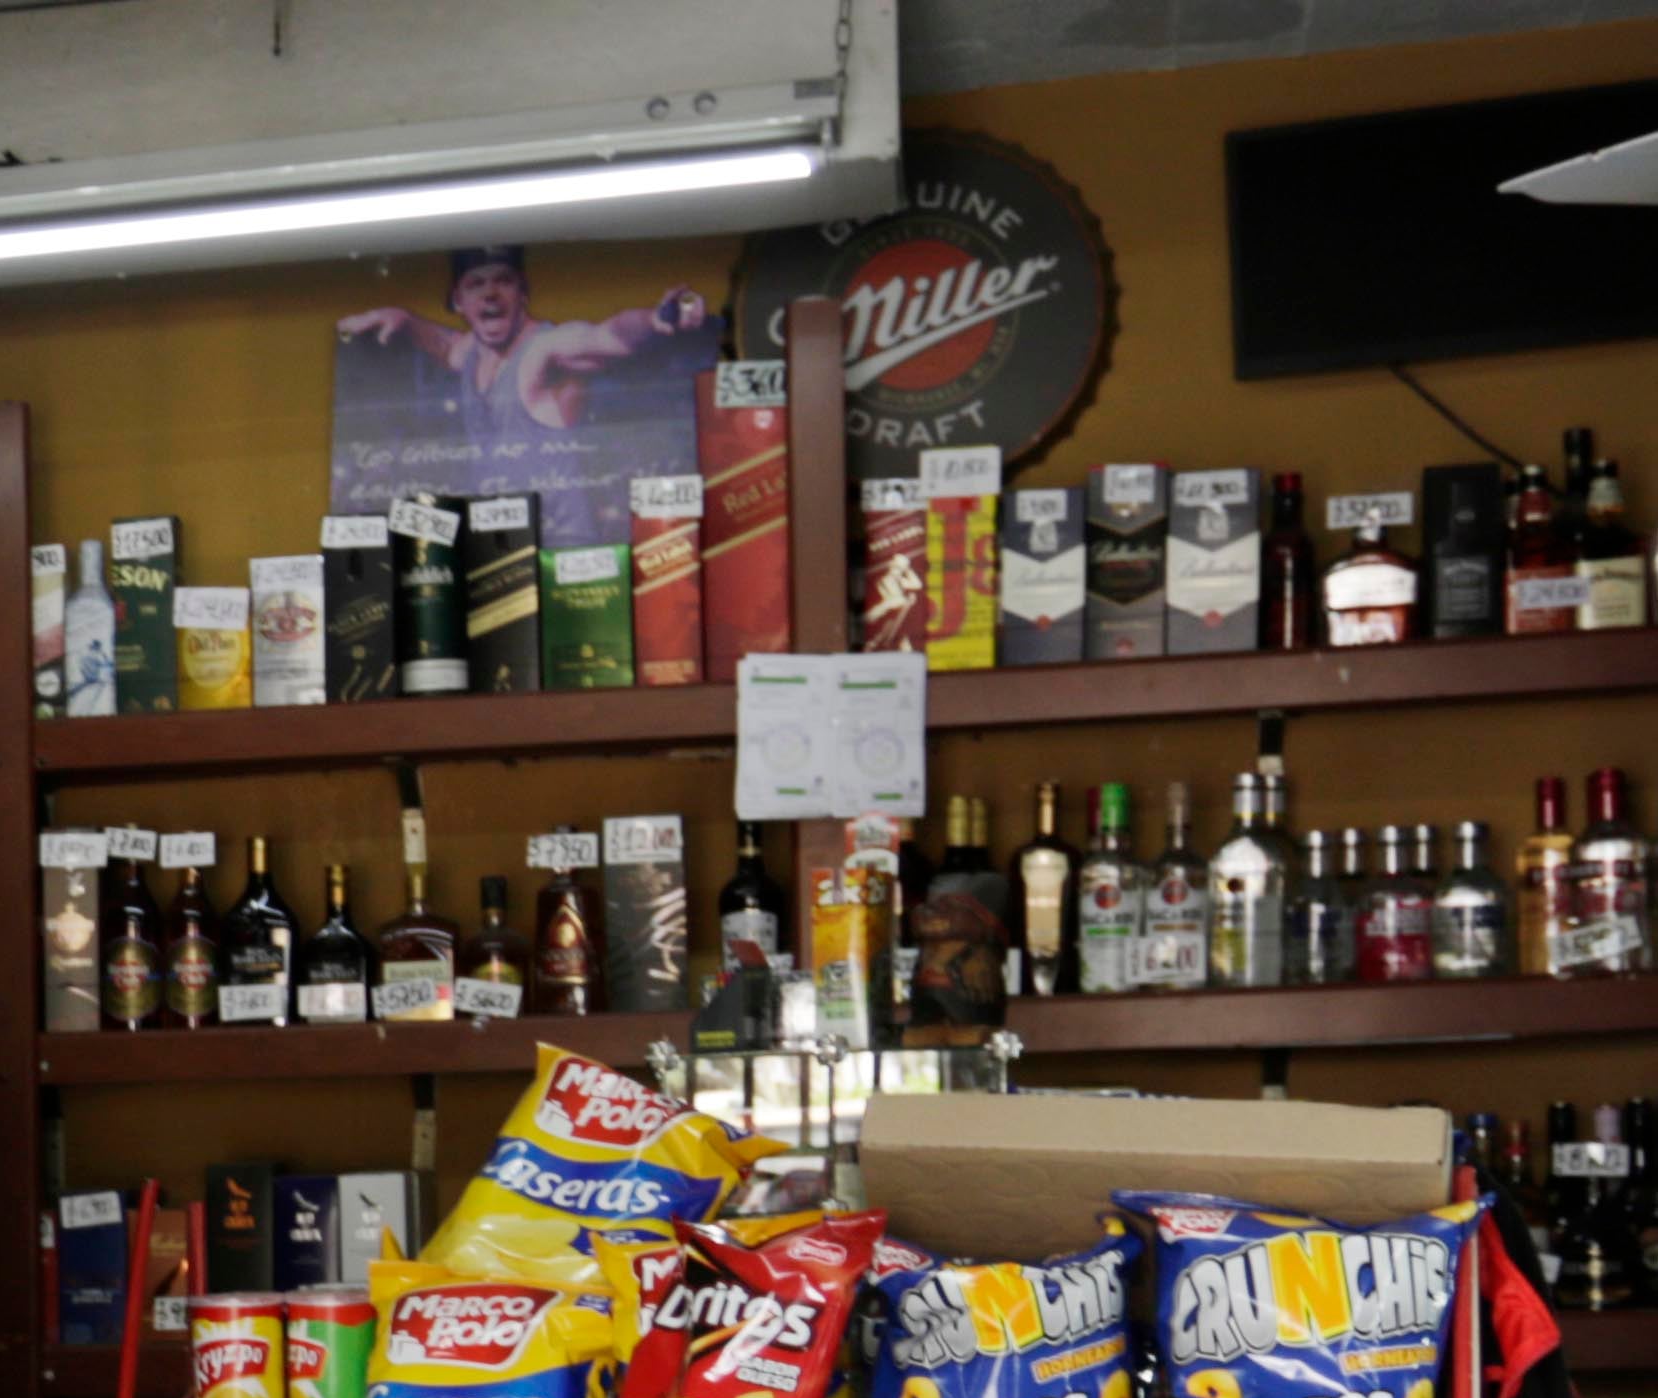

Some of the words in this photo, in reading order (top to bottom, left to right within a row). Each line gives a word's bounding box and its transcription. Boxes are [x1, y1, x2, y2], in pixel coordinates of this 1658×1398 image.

[822, 182, 1022, 246] GUINE
[842, 256, 1059, 362] Miller
[846, 401, 985, 449] DRAFT
[577, 1097, 666, 1133] Polo
[483, 1138, 672, 1217] Caseras
[398, 1293, 534, 1328] Marco
[426, 1313, 532, 1350] Polo
[654, 1281, 818, 1351] Doritos
